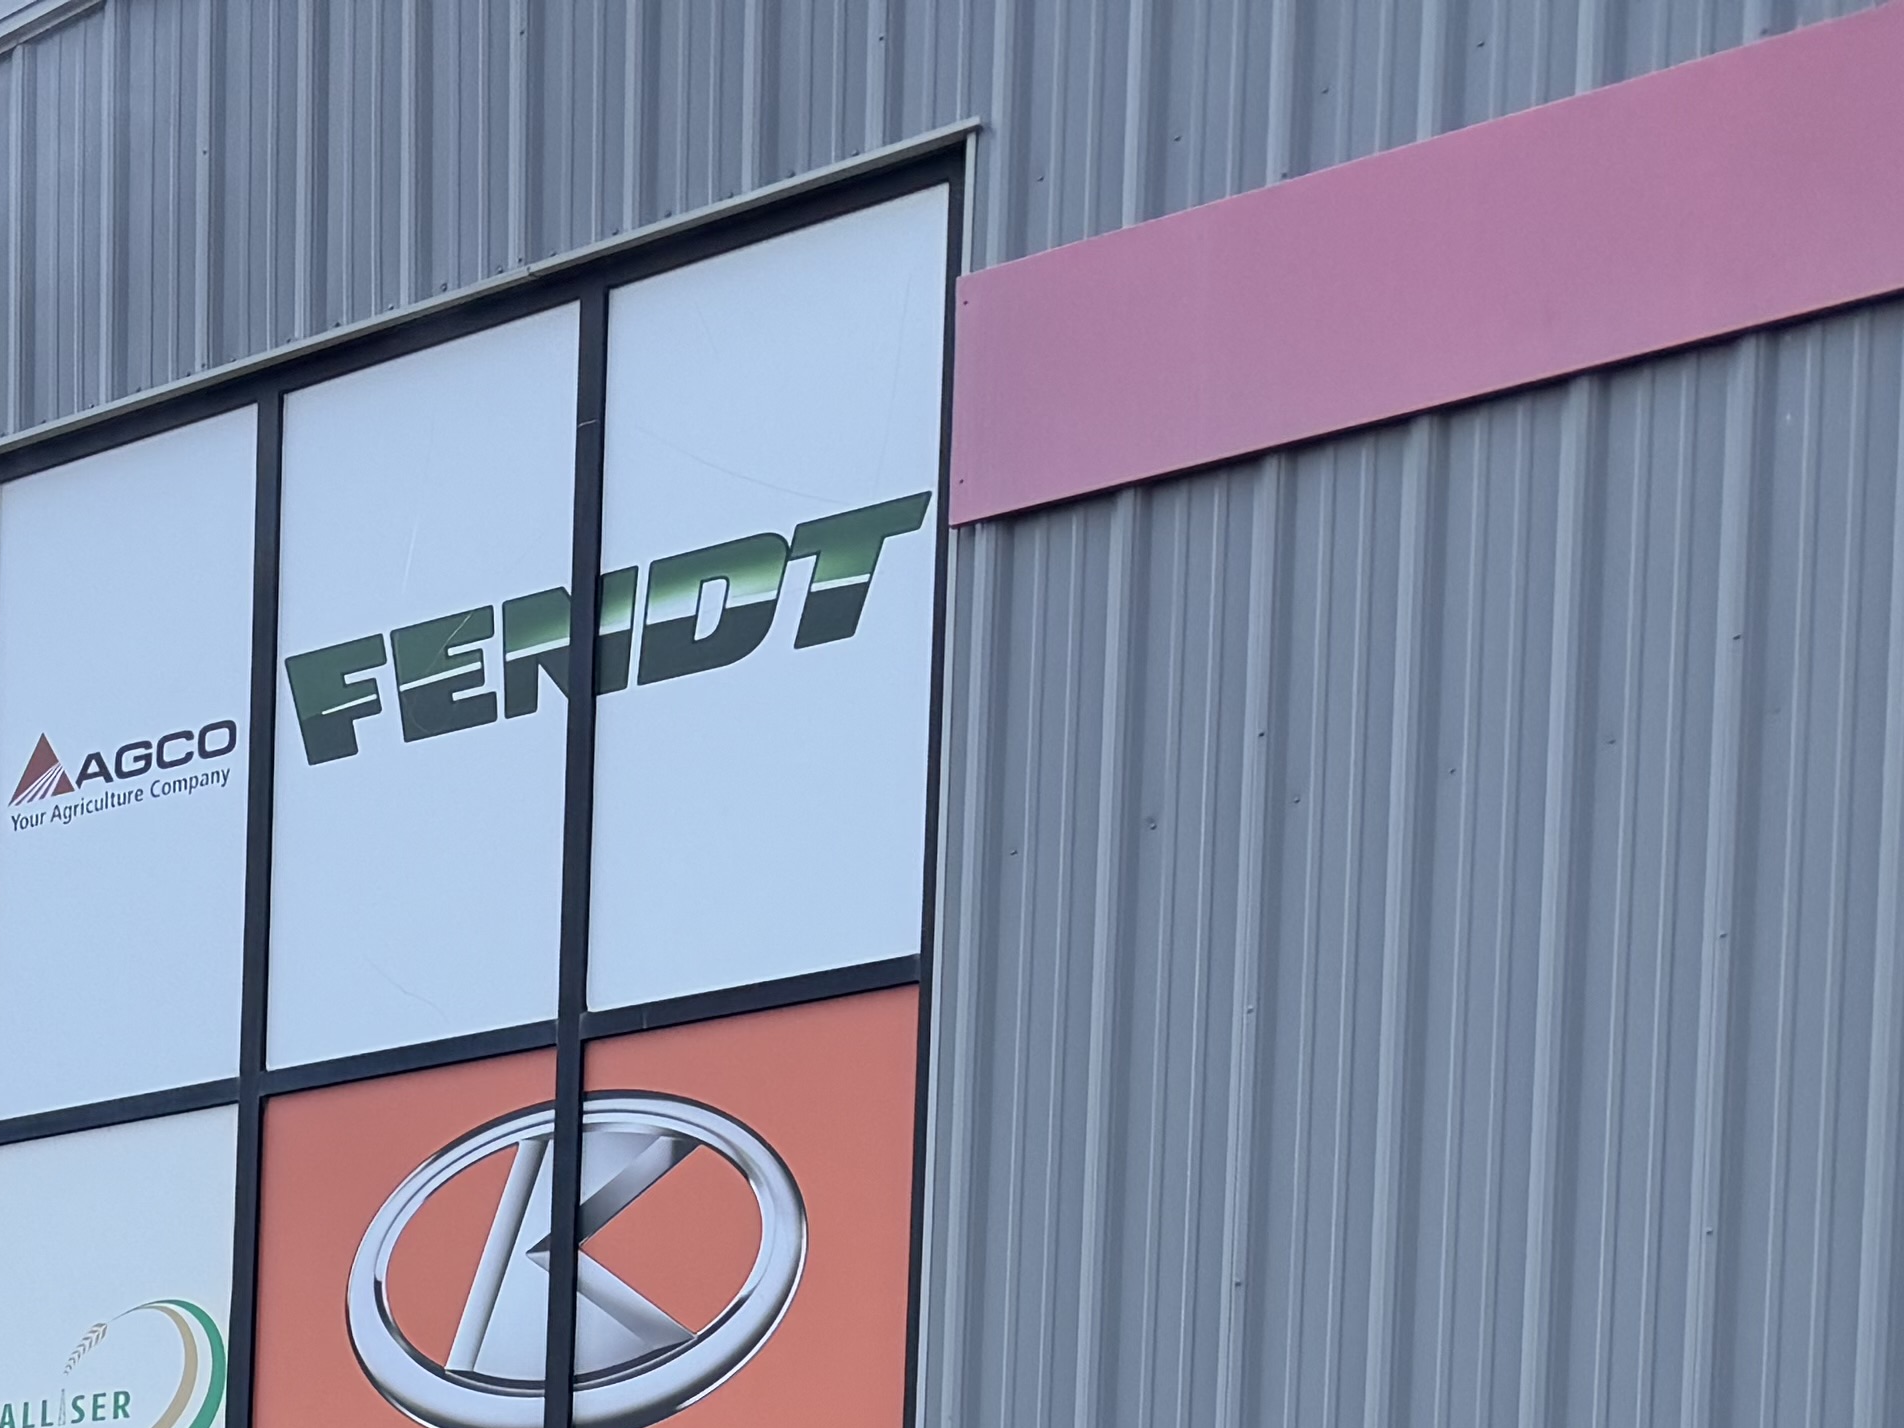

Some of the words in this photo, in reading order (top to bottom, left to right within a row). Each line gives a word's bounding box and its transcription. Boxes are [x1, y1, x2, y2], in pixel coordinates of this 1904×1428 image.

[285, 491, 932, 766] FENDT
[75, 720, 237, 789] AGCO
[11, 812, 46, 832] Your
[50, 787, 144, 825] Agriculture
[150, 768, 230, 798] Company
